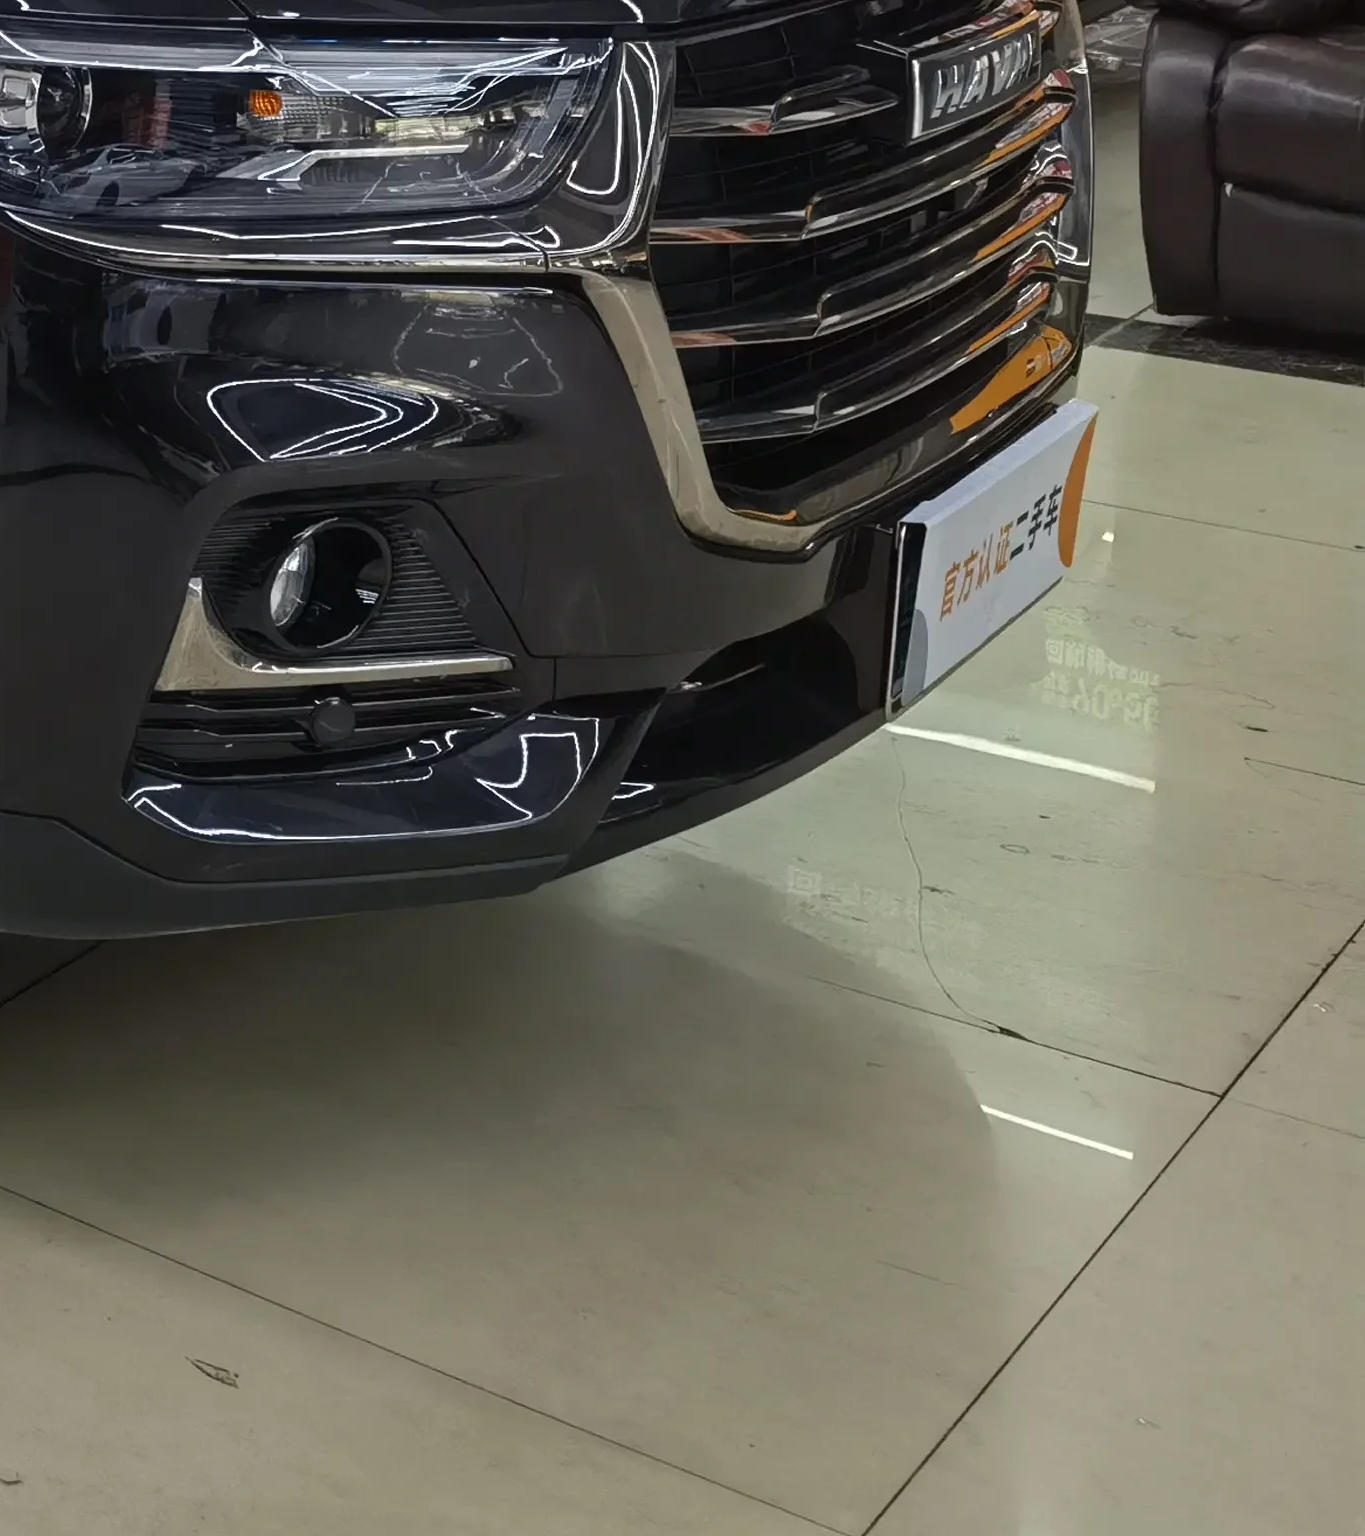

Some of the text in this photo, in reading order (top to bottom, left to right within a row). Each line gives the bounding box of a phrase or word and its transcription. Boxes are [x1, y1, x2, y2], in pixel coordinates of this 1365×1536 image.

[939, 483, 1064, 622] 官方认证二手车
